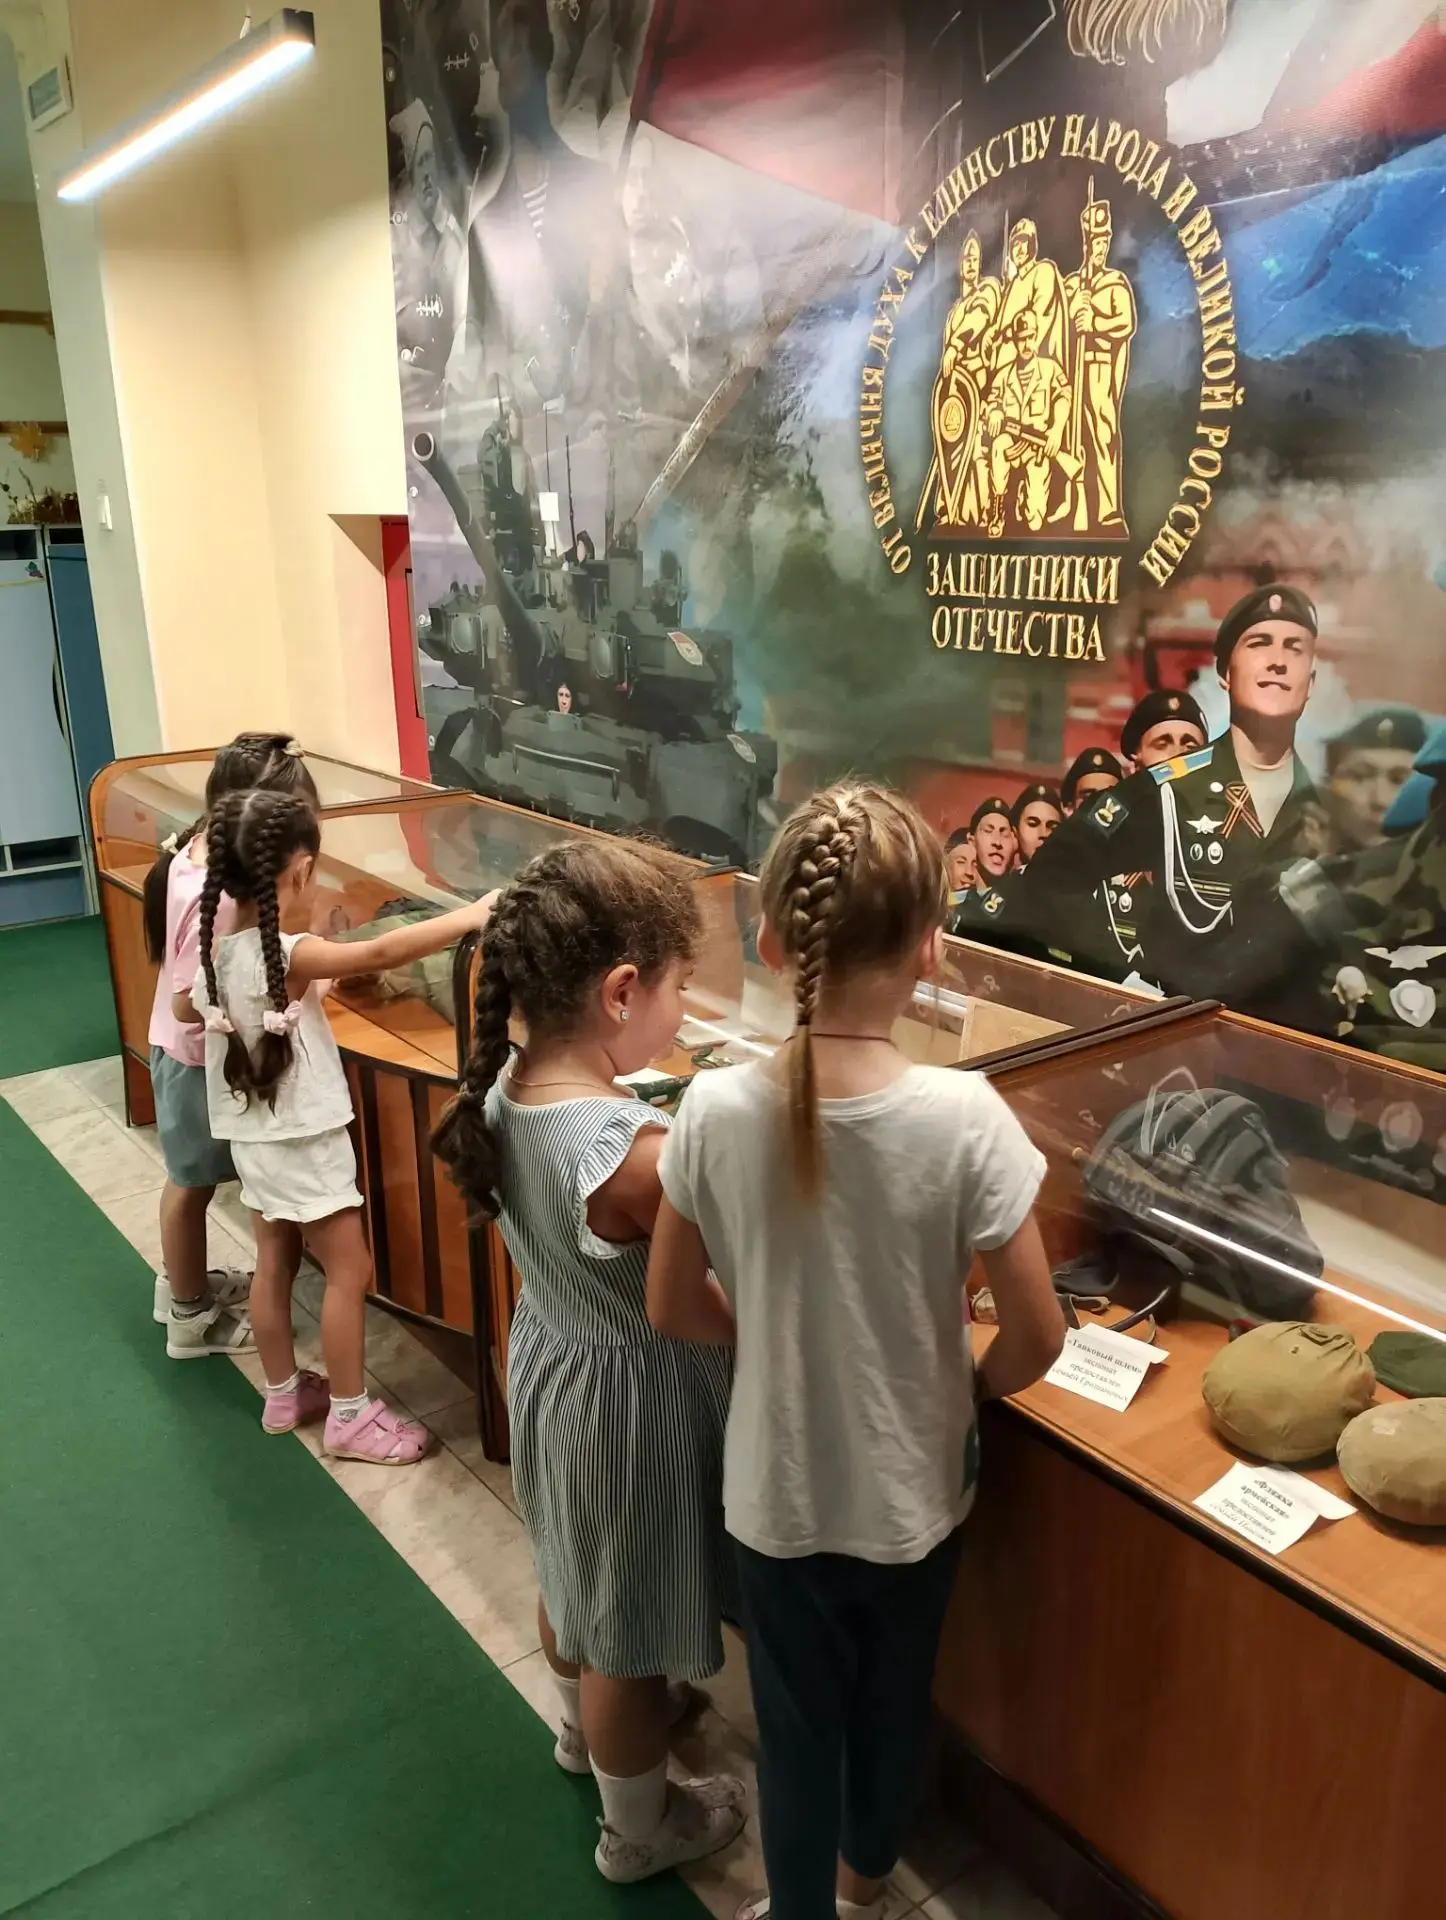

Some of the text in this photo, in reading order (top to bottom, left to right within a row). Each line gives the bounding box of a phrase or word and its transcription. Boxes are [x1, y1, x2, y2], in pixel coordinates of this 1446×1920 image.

[917, 114, 1057, 236] ЕДИНСТВУ
[1060, 113, 1174, 200] НАРОДА
[1161, 173, 1200, 224] И
[904, 234, 929, 267] К
[868, 266, 914, 361] ДУХА
[1178, 207, 1243, 413] ВЕЛИКОЙ
[1139, 425, 1231, 588] РОССИИ
[881, 527, 912, 574] ОТ
[925, 552, 1122, 605] ЗАЩИТНИКИ
[932, 605, 1107, 662] ОТЕЧЕСТВА
